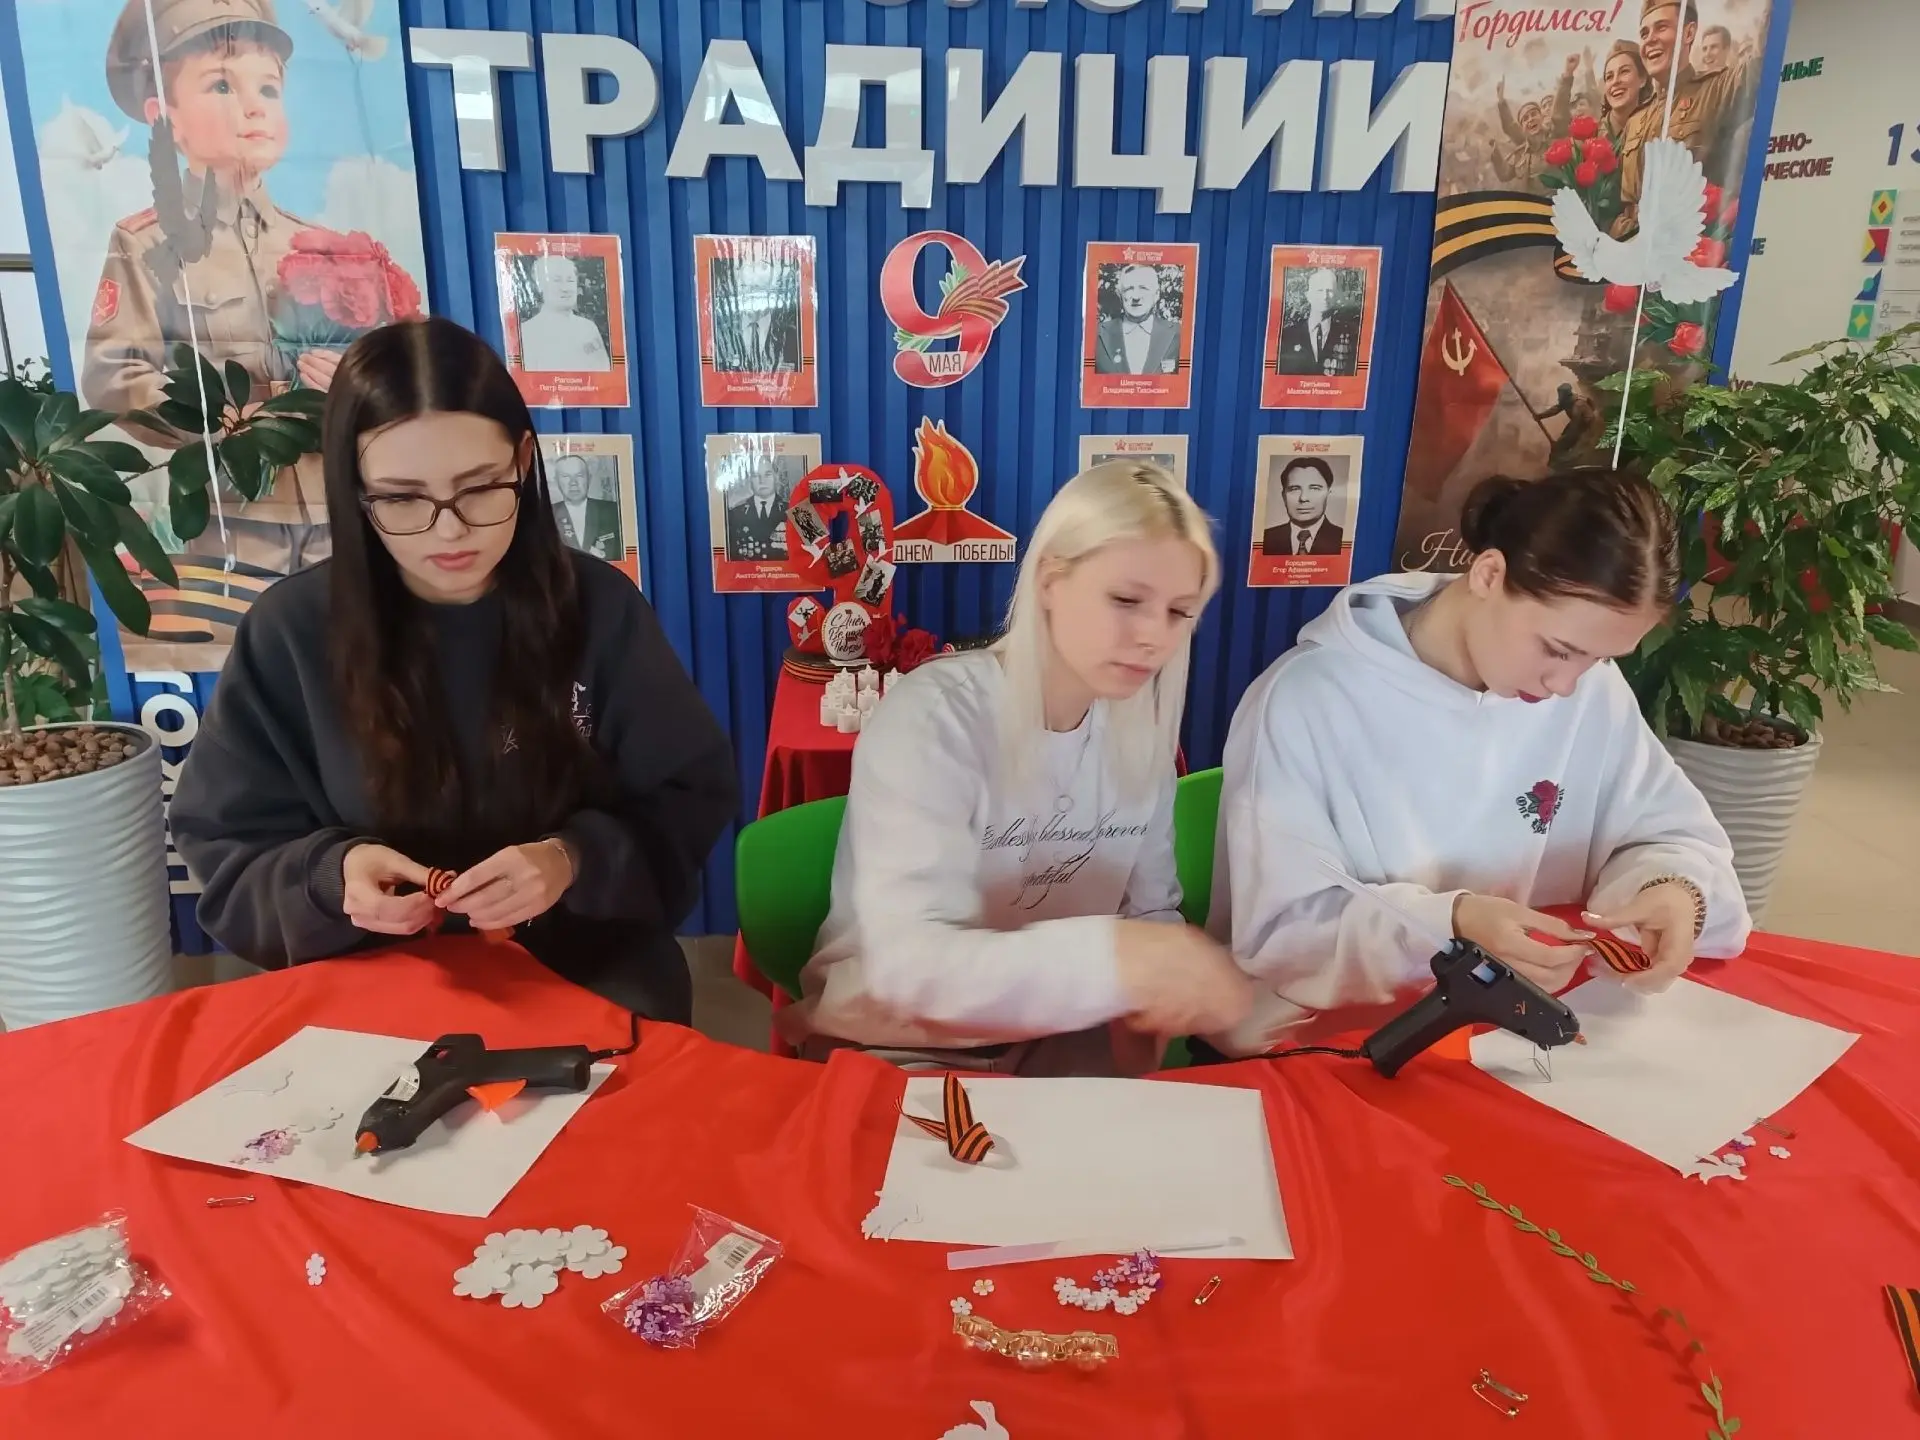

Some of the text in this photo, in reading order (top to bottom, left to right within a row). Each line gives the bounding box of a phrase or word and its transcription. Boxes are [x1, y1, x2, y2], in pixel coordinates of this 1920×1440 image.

[1459, 0, 1624, 50] Гордимся!
[410, 27, 1450, 213] ТРАДИЦИИ
[929, 353, 962, 373] МАЯ
[895, 543, 1014, 562] ДНЕМ ПОБЕДЫ!
